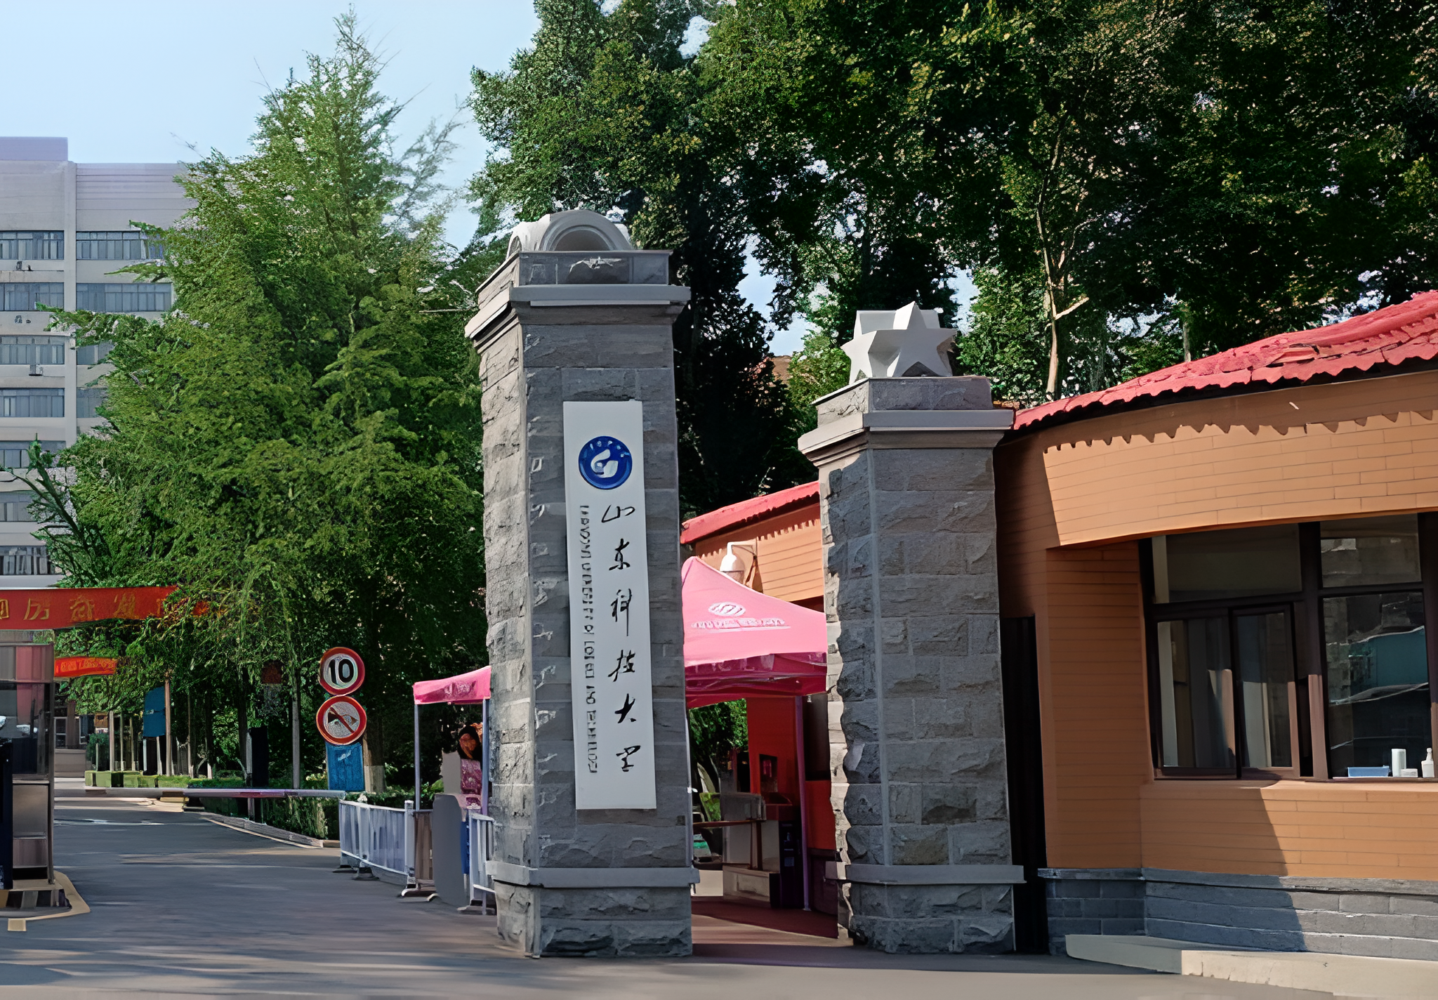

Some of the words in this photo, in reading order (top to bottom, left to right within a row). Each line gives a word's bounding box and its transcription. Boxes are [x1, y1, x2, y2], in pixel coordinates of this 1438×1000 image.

[328, 658, 355, 685] 10
[601, 504, 641, 773] 山东科技大学
